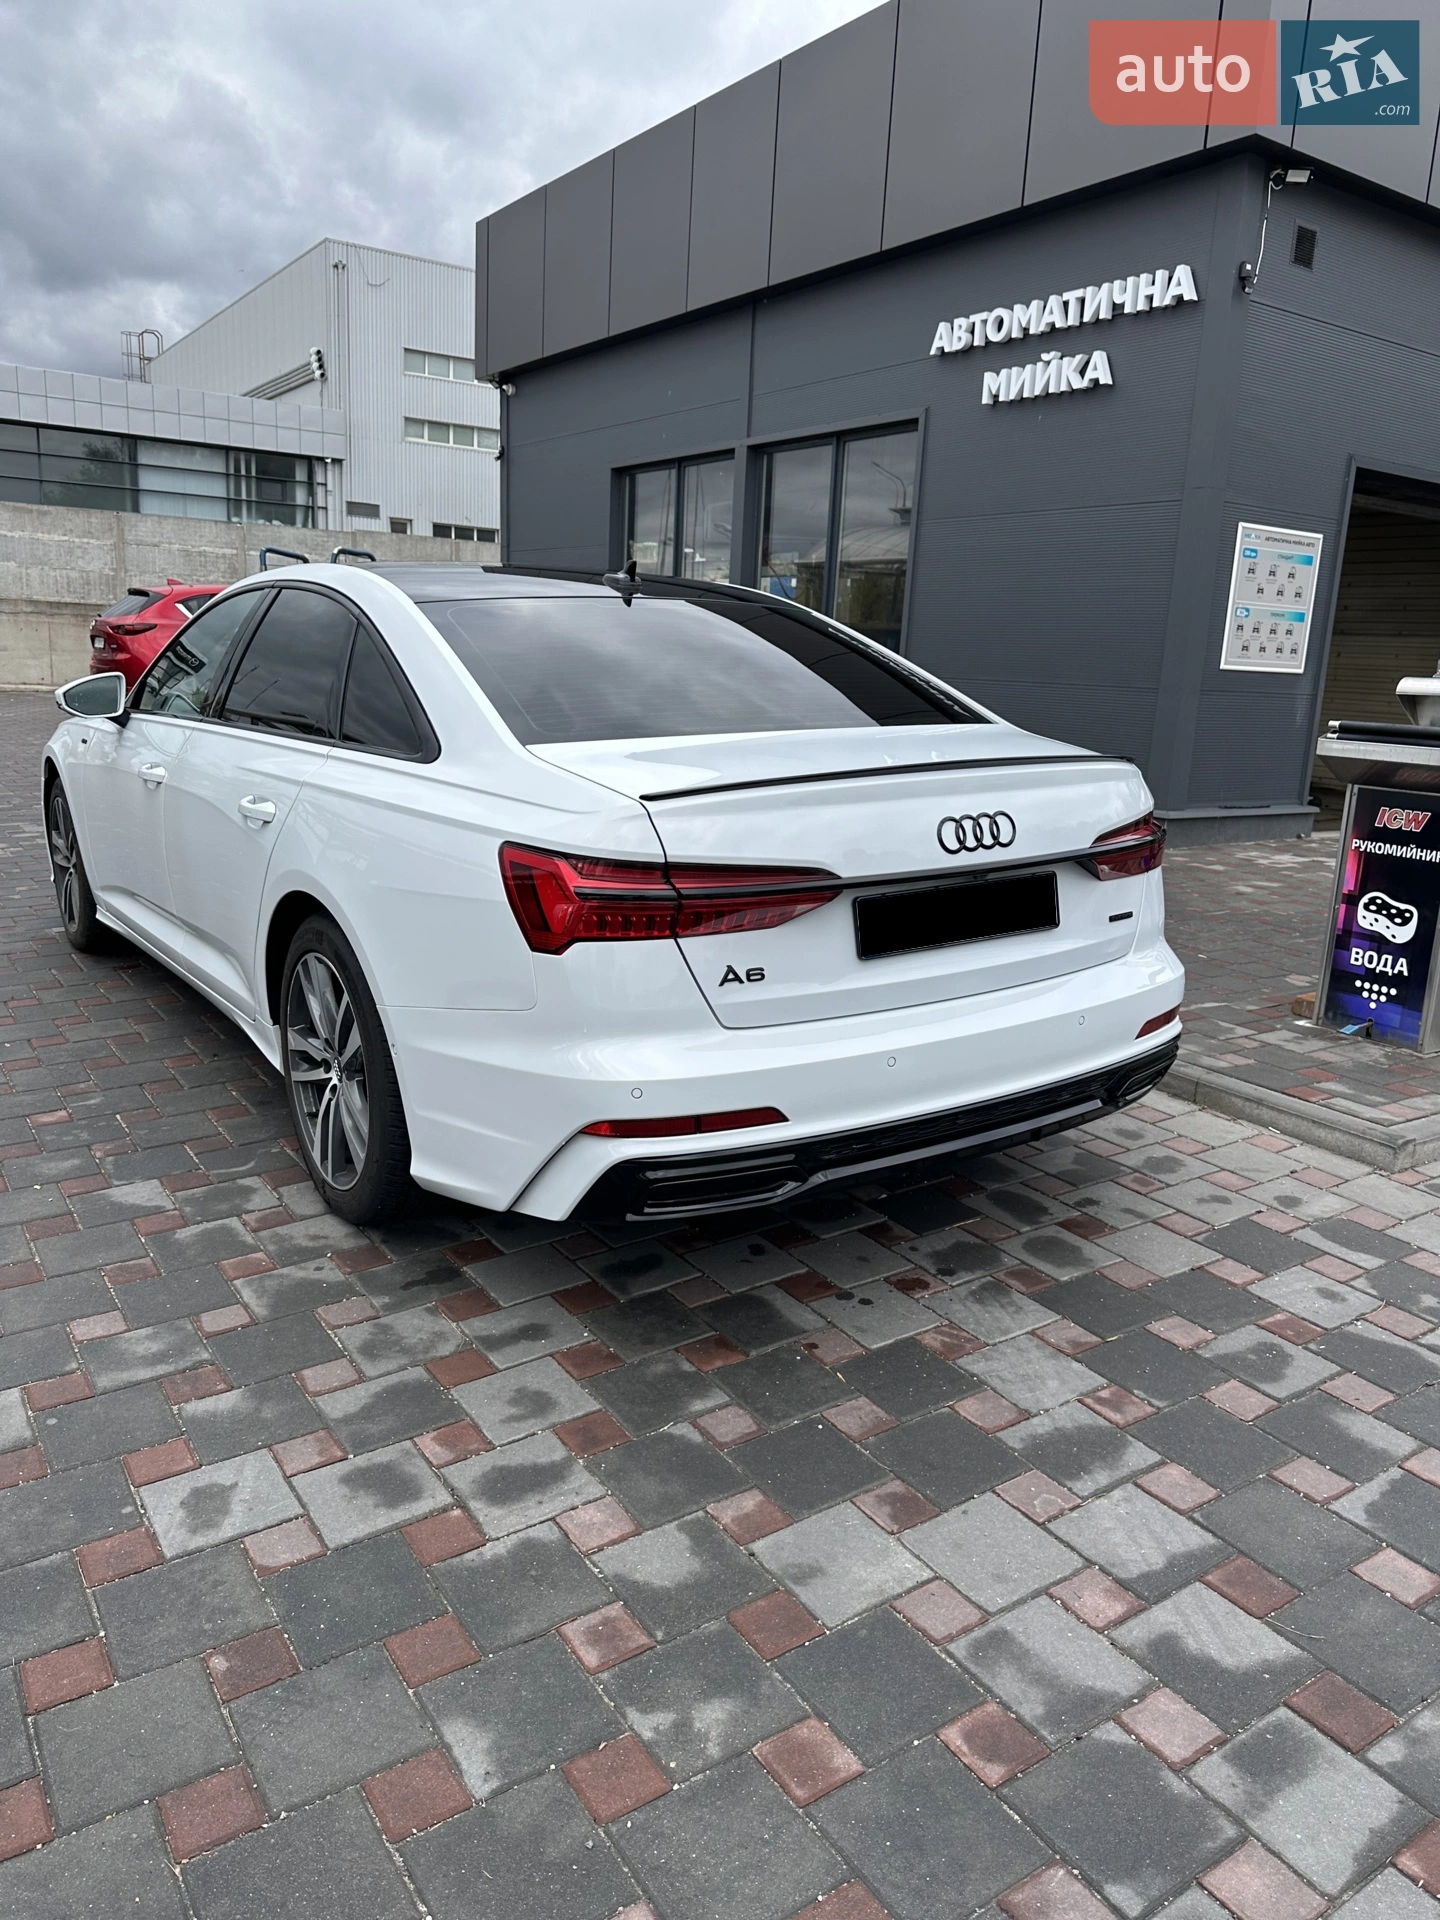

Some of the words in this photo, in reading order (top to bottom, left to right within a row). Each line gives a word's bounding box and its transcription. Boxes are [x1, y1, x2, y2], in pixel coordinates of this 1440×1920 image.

[929, 263, 1199, 356] АВТОМАТИЧНА
[981, 350, 1114, 405] МИЙКА
[1374, 806, 1432, 833] ICW
[718, 964, 766, 987] A6
[1350, 947, 1409, 977] ВОДА
